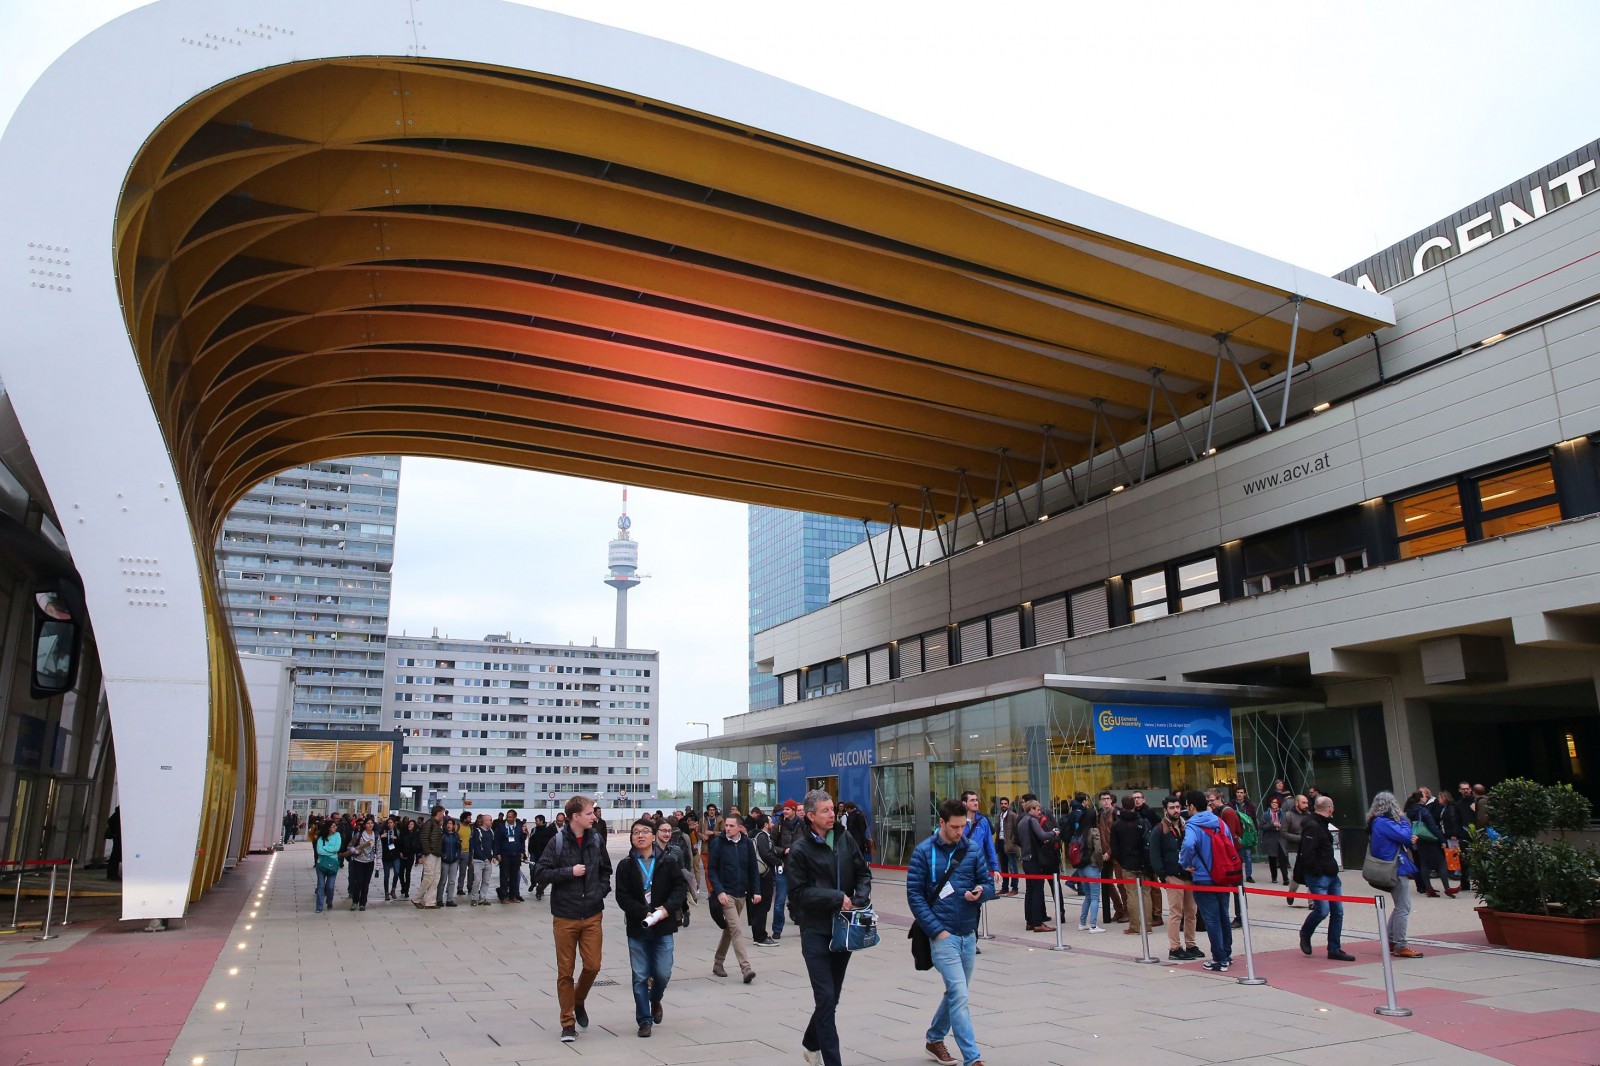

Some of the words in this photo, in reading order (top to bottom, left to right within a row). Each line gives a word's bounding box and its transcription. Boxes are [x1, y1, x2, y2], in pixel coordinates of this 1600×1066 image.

[1243, 452, 1331, 495] www.acv.at
[1145, 734, 1208, 748] WELCOME
[829, 749, 873, 768] WELCOME
